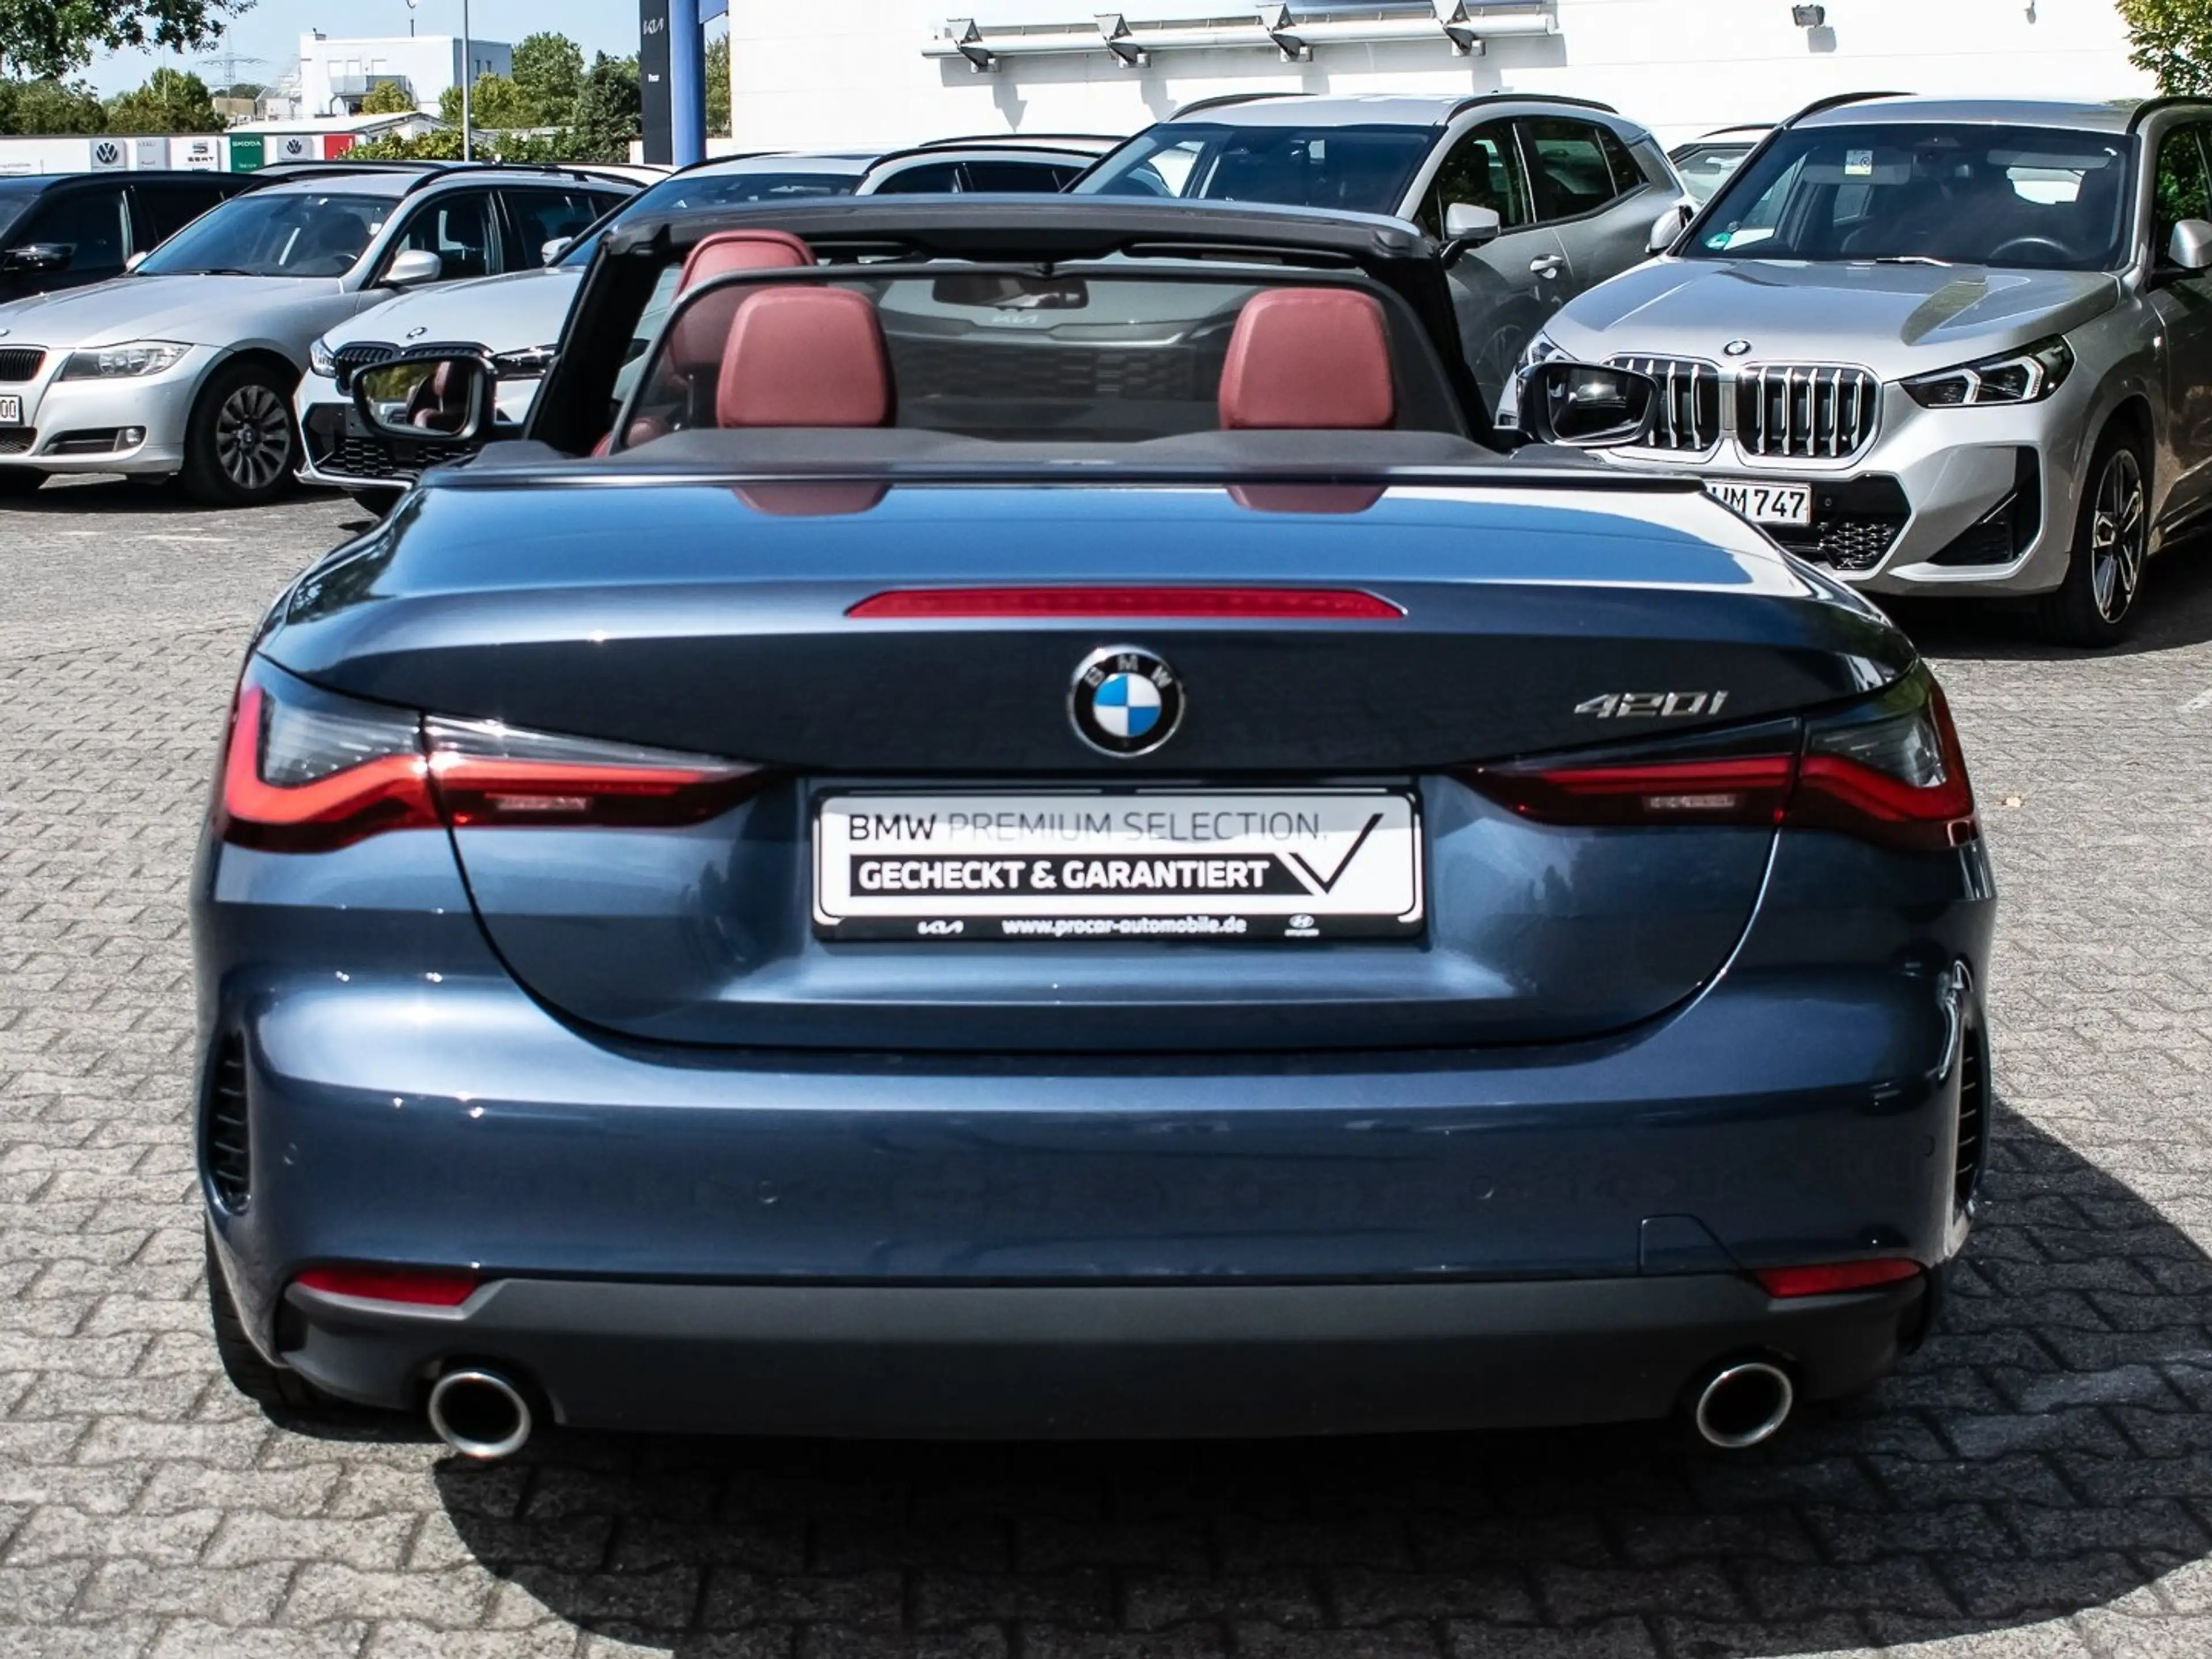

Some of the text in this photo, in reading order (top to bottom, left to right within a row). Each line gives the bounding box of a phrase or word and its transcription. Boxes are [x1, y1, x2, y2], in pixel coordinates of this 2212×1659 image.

[1754, 490, 1805, 518] 747
[1084, 654, 1173, 689] BMW
[849, 813, 937, 841] BMW
[949, 813, 1112, 842] PREMIUM
[858, 860, 1270, 889] GECHECKT & GARANTIERT
[1001, 916, 1247, 937] www.procar-automobile.de
